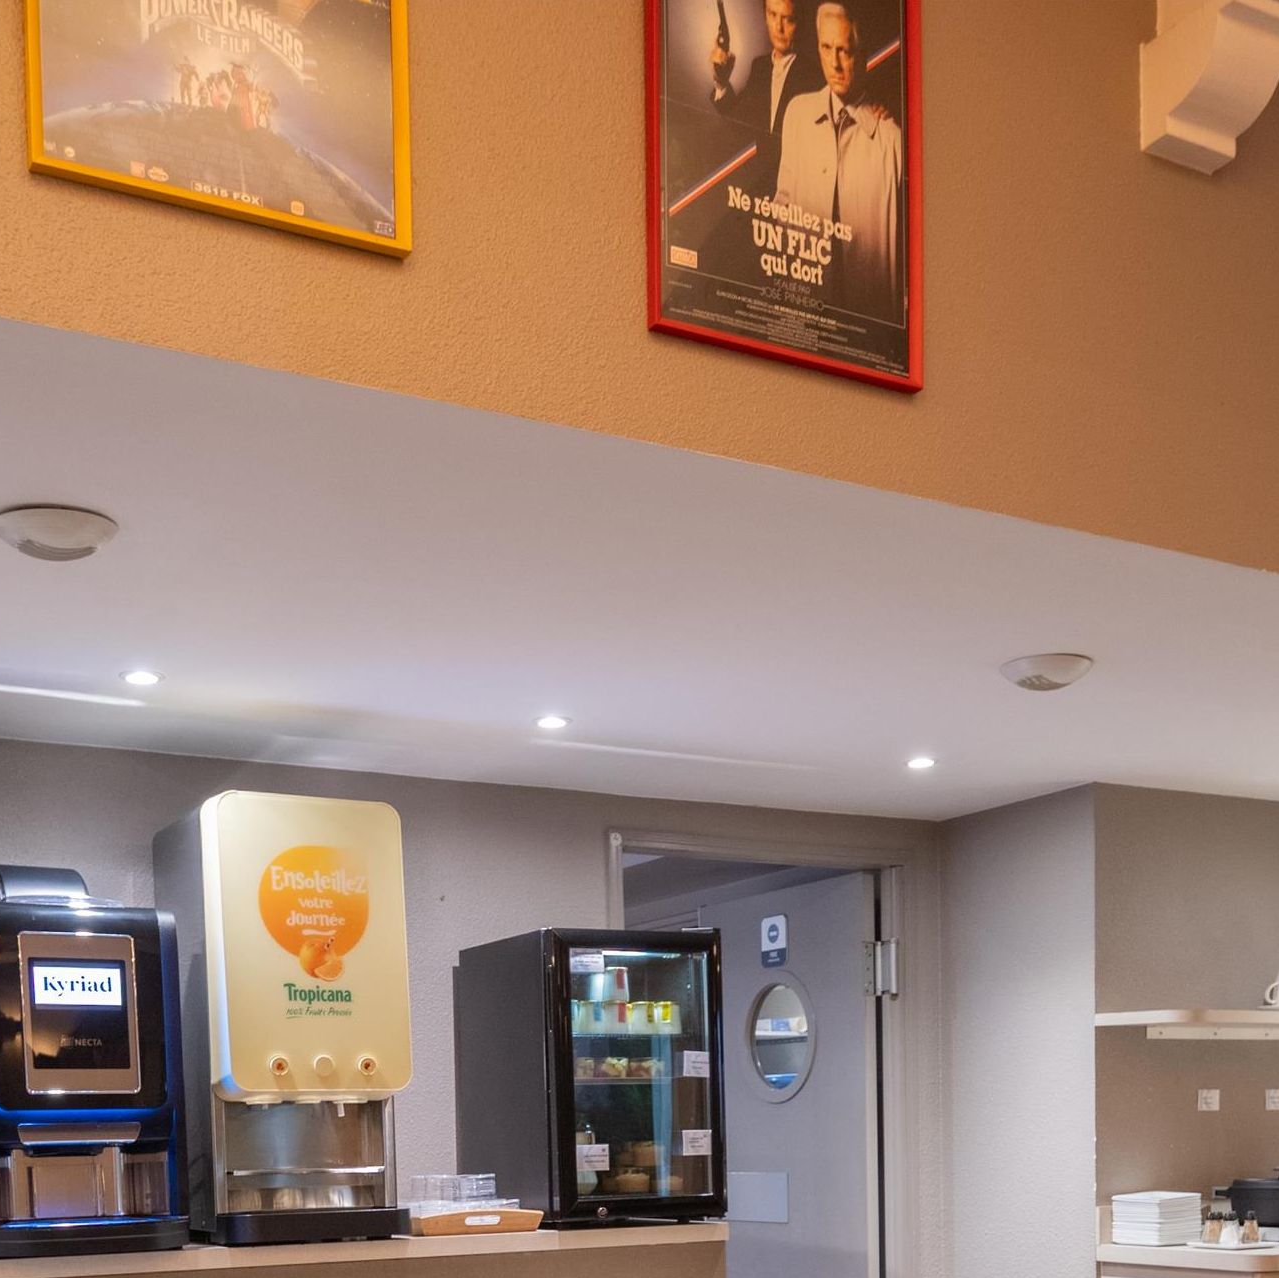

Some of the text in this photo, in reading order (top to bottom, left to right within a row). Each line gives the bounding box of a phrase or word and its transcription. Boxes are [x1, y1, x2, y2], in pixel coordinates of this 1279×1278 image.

[196, 23, 250, 54] LE FILM
[222, 0, 305, 70] RANGERS
[232, 186, 262, 207] FOX
[727, 184, 853, 243] Ne réveillez pas
[751, 218, 833, 266] UN FLIC
[760, 251, 824, 286] qui dort
[270, 865, 368, 896] Ensoleillez
[298, 896, 334, 909] votre
[43, 975, 112, 997] Kyriad
[283, 982, 353, 1005] Tropicana
[74, 1038, 103, 1047] NECTA
